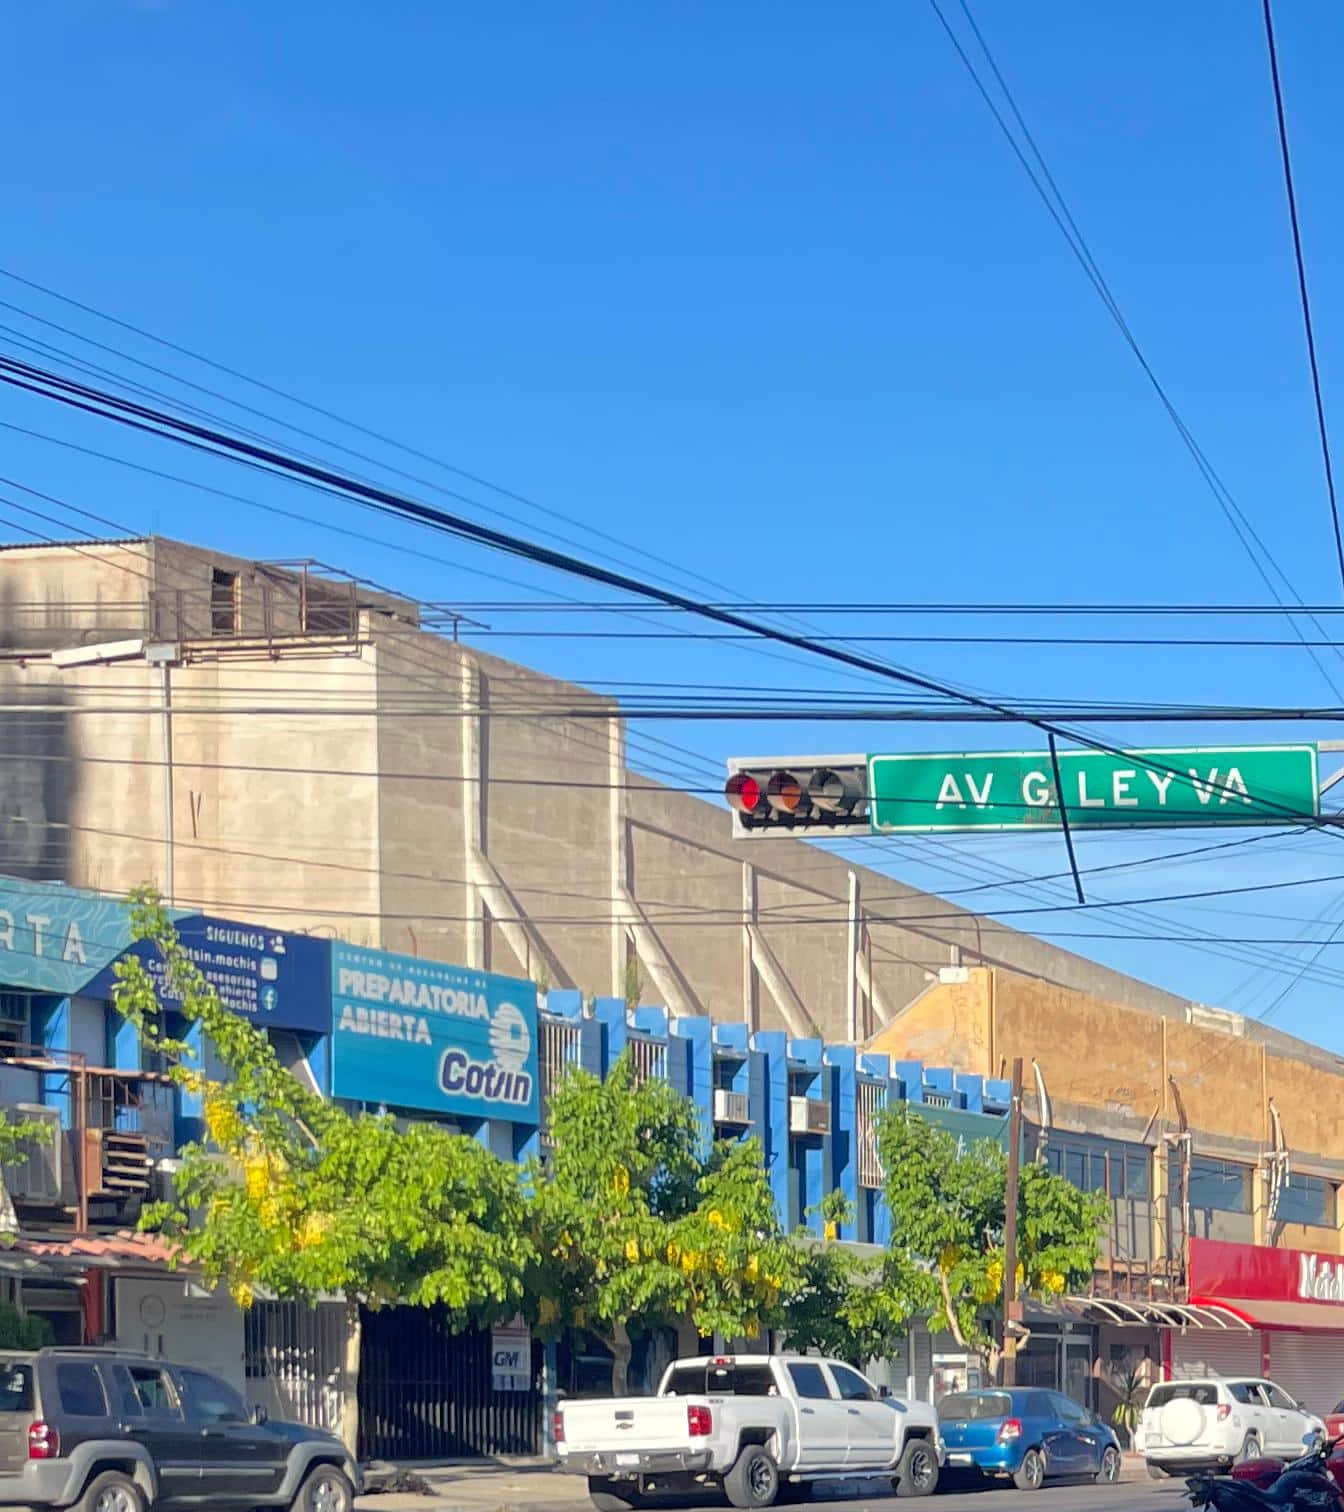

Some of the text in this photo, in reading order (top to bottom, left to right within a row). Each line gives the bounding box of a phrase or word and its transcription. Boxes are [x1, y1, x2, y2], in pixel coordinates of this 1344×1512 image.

[1077, 767, 1252, 808] LEYVA
[338, 967, 490, 1021] PREPARATORIA
[338, 1004, 433, 1046] ABIERTA
